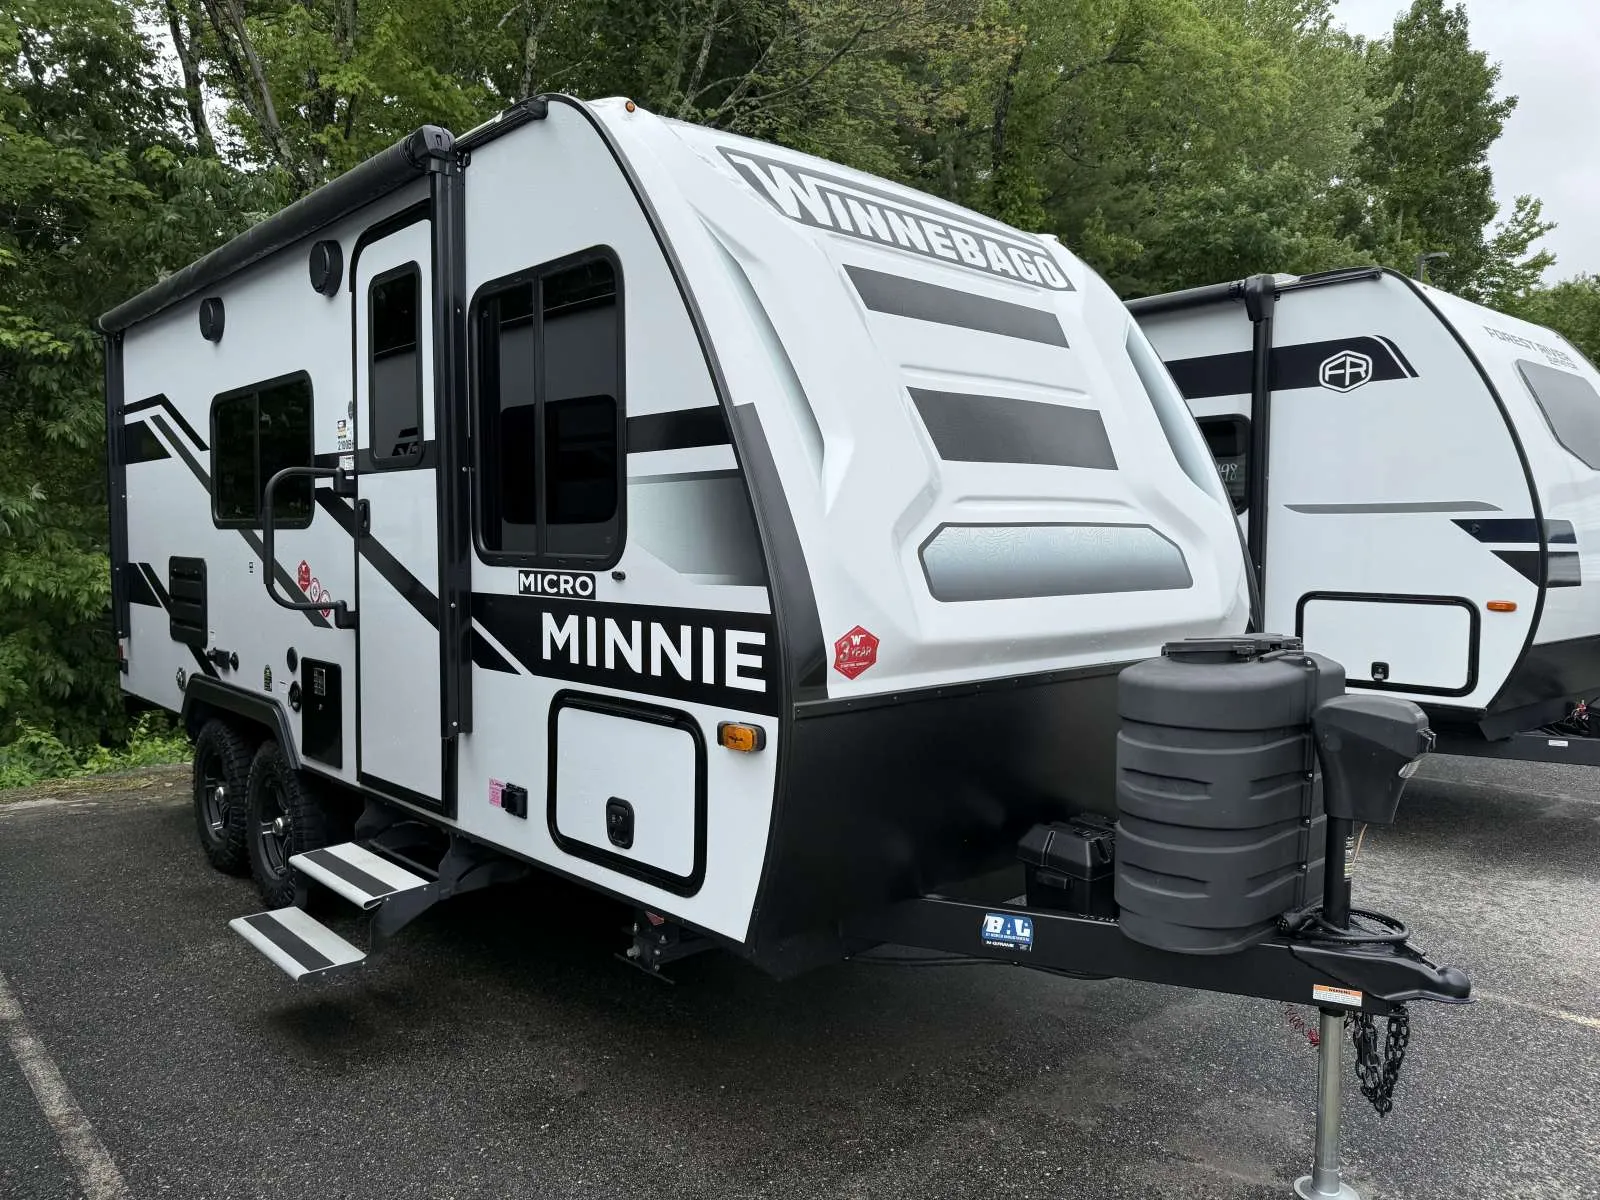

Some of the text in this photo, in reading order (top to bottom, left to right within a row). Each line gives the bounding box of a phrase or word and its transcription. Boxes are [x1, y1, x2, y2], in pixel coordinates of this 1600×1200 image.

[726, 152, 1068, 290] WINNEBAGO
[1482, 325, 1537, 352] FOREST
[519, 573, 594, 597] MICRO
[542, 612, 767, 693] MINNIE
[850, 645, 872, 658] YEAR
